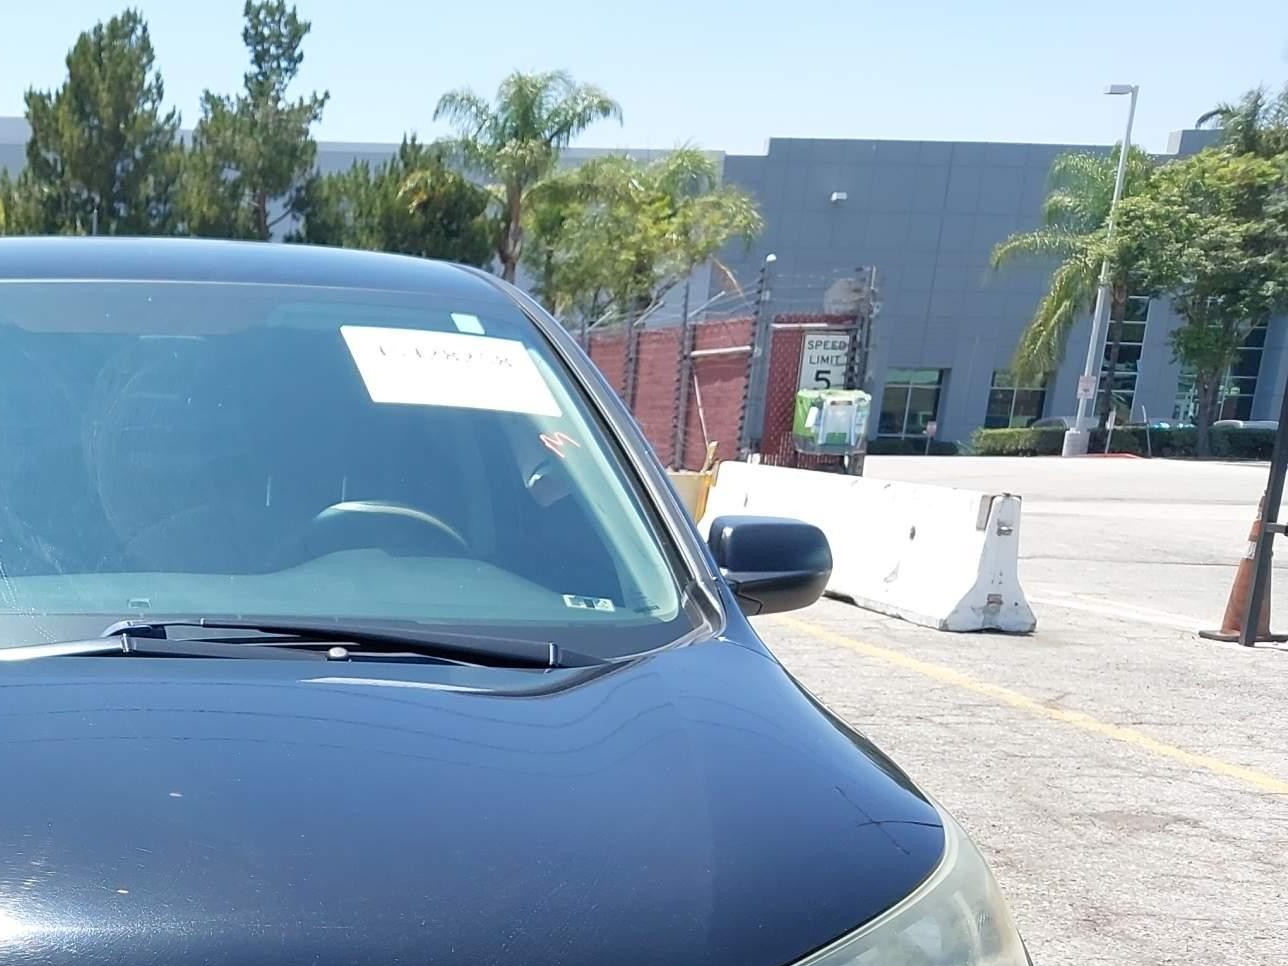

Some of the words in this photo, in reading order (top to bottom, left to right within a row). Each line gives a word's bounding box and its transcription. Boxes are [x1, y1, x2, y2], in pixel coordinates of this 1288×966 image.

[807, 340, 847, 350] SPEED
[809, 355, 841, 365] LIMIT
[815, 370, 831, 389] 5
